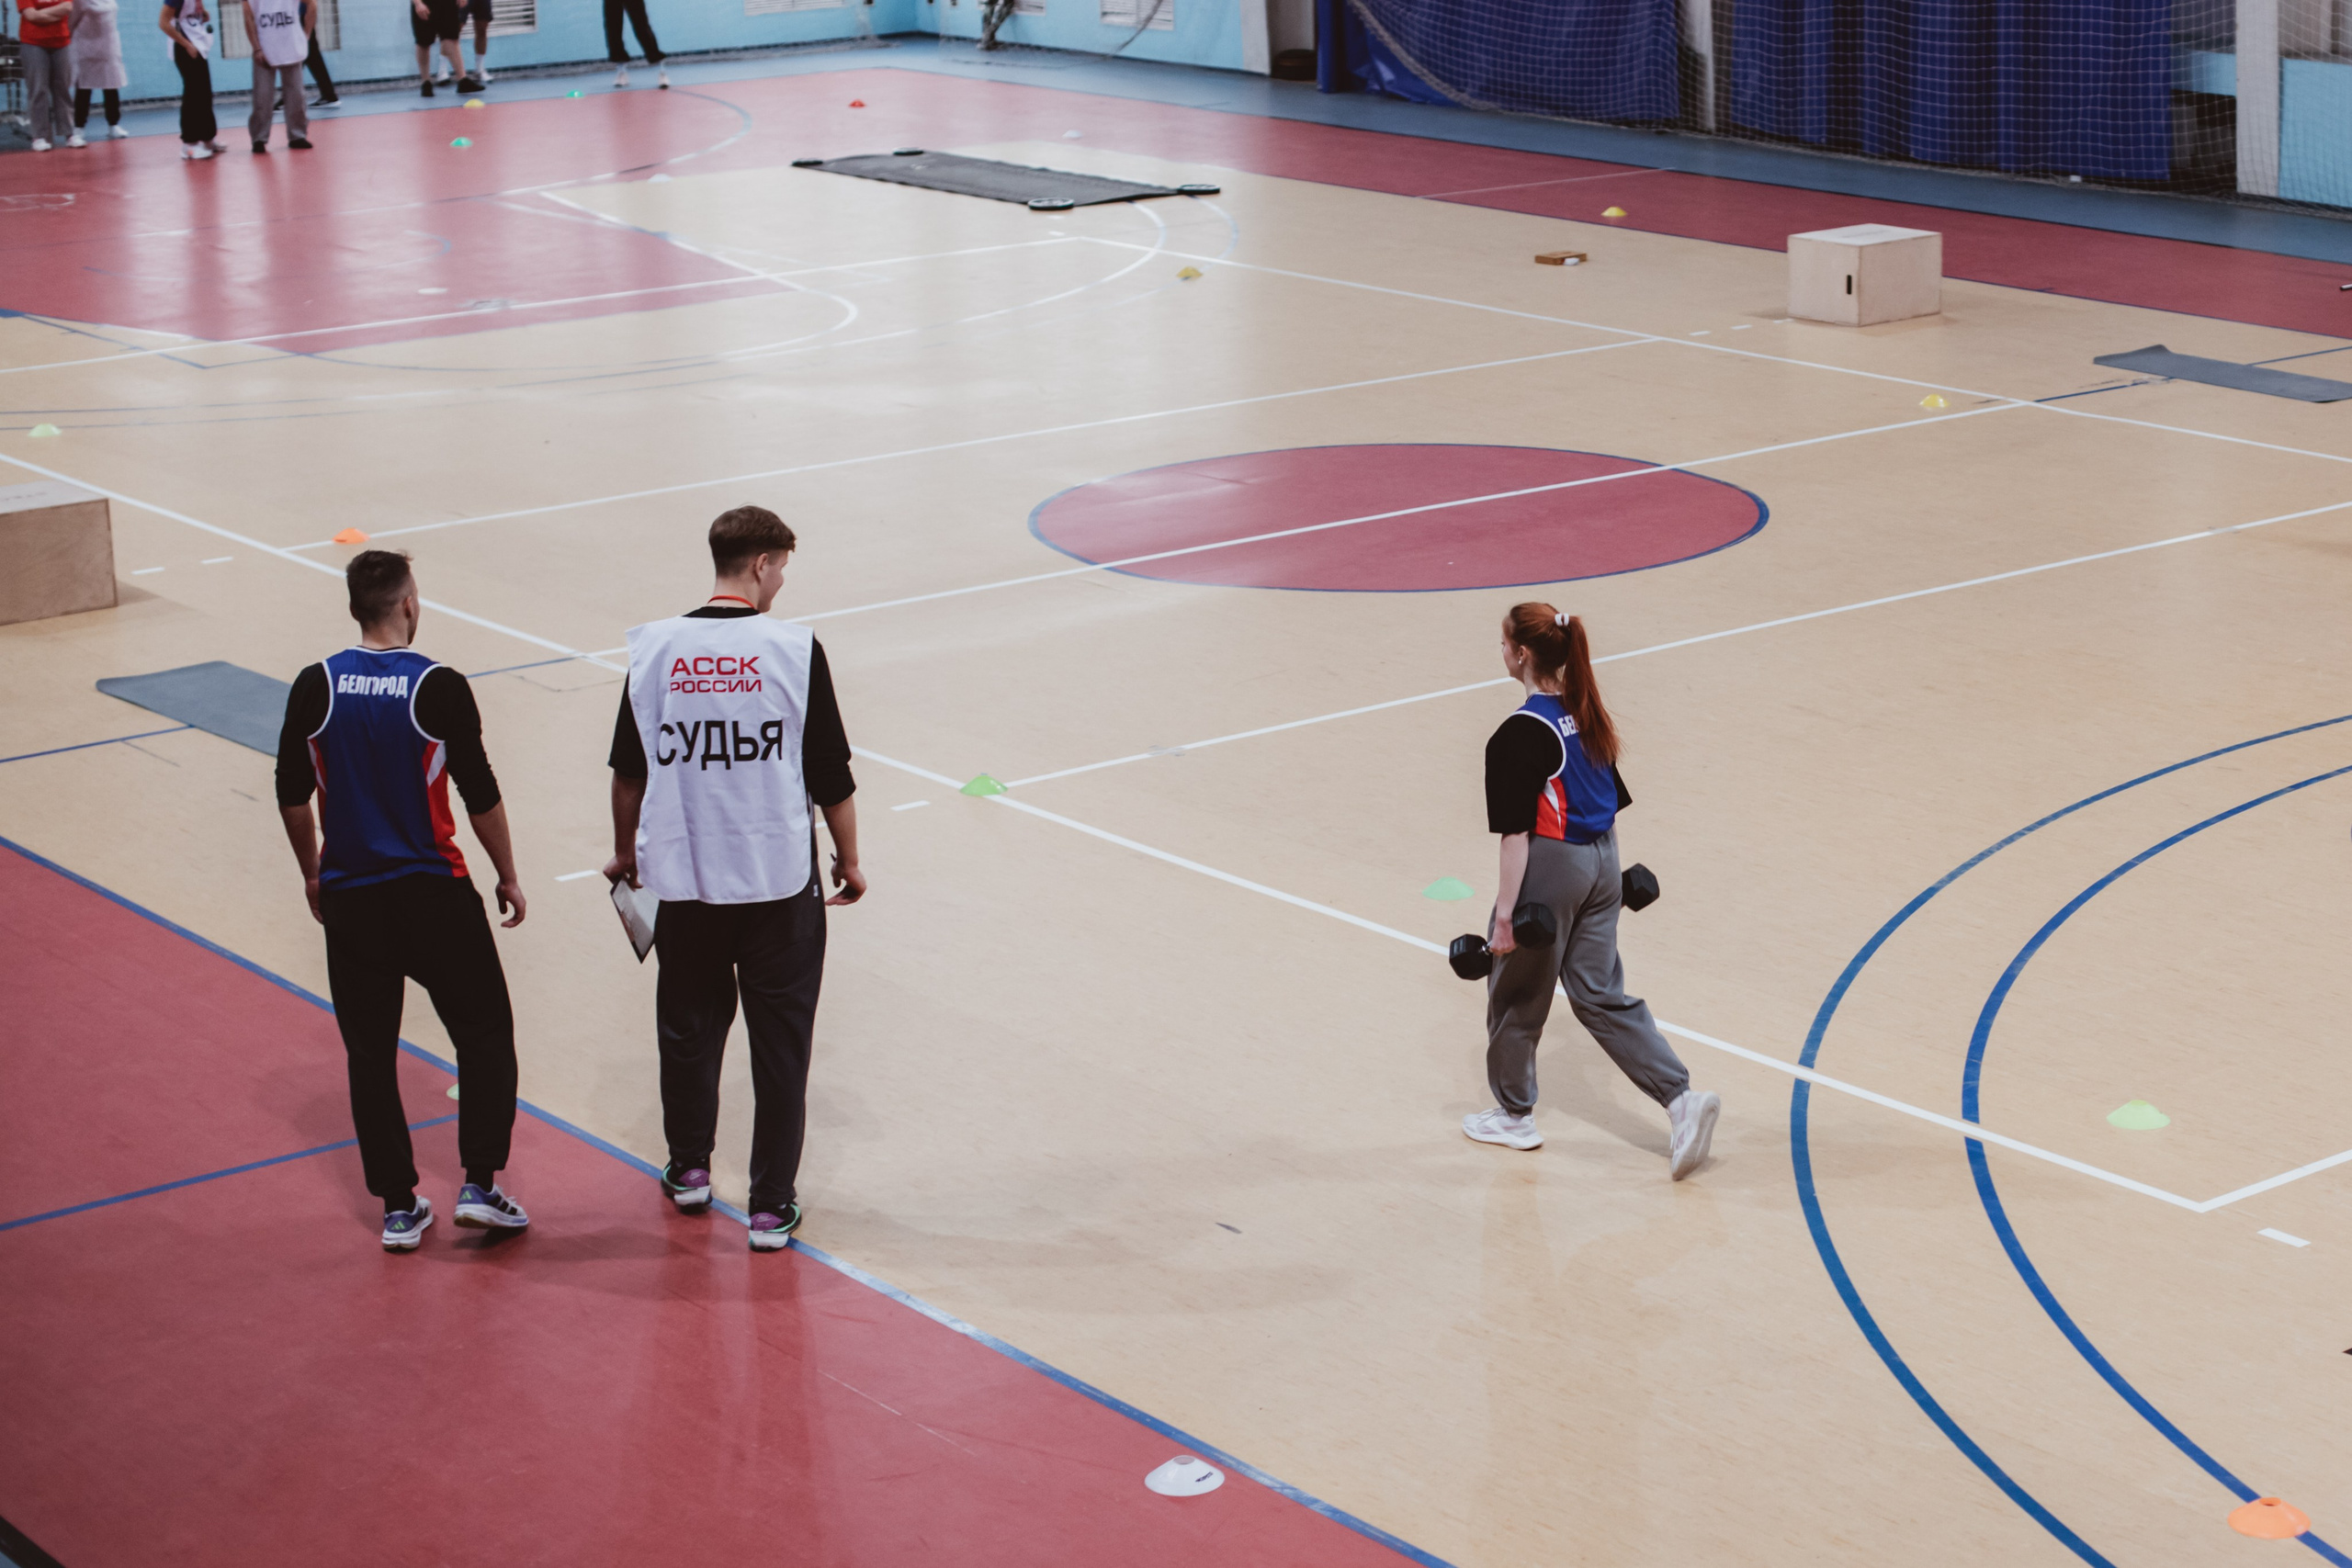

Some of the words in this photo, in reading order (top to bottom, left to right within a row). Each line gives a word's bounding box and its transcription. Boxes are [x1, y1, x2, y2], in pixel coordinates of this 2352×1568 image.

[670, 656, 761, 677] АССК
[336, 673, 409, 698] БЕЛГОРОД
[670, 679, 763, 694] РОССИИ
[1557, 715, 1579, 738] БЕ
[656, 719, 784, 771] СУДЬЯ
